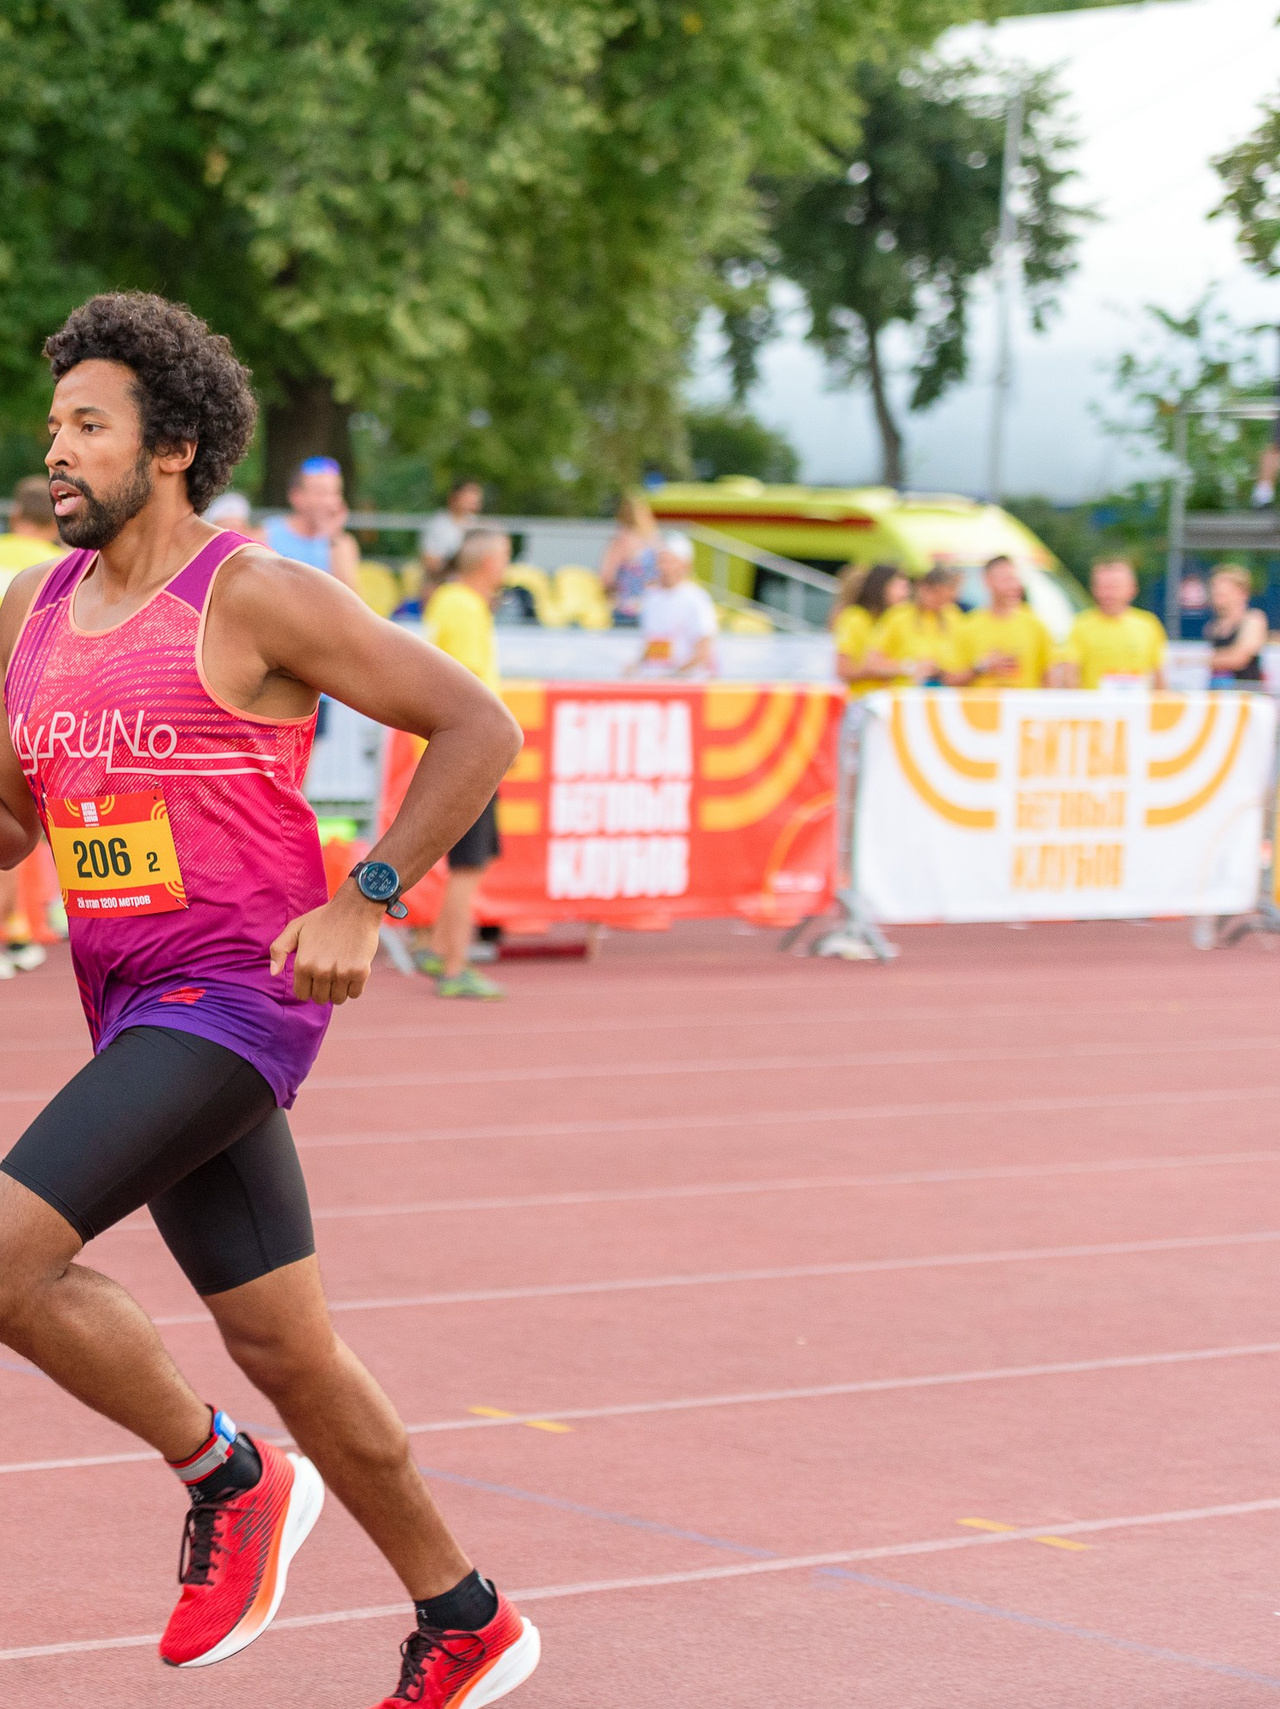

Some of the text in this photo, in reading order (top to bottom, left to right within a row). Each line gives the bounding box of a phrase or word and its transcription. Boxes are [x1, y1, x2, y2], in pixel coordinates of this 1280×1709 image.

[553, 700, 692, 777] БИТВА
[1018, 719, 1128, 778] БИТВА
[550, 780, 691, 835] БЕГОВЫХ
[1015, 790, 1126, 830] БЕГОВЫХ
[73, 838, 161, 878] 206 2
[547, 836, 689, 899] КЛУБОВ
[1011, 843, 1124, 892] КЛУБОВ
[100, 897, 118, 909] 1200
[118, 895, 152, 908] метров
